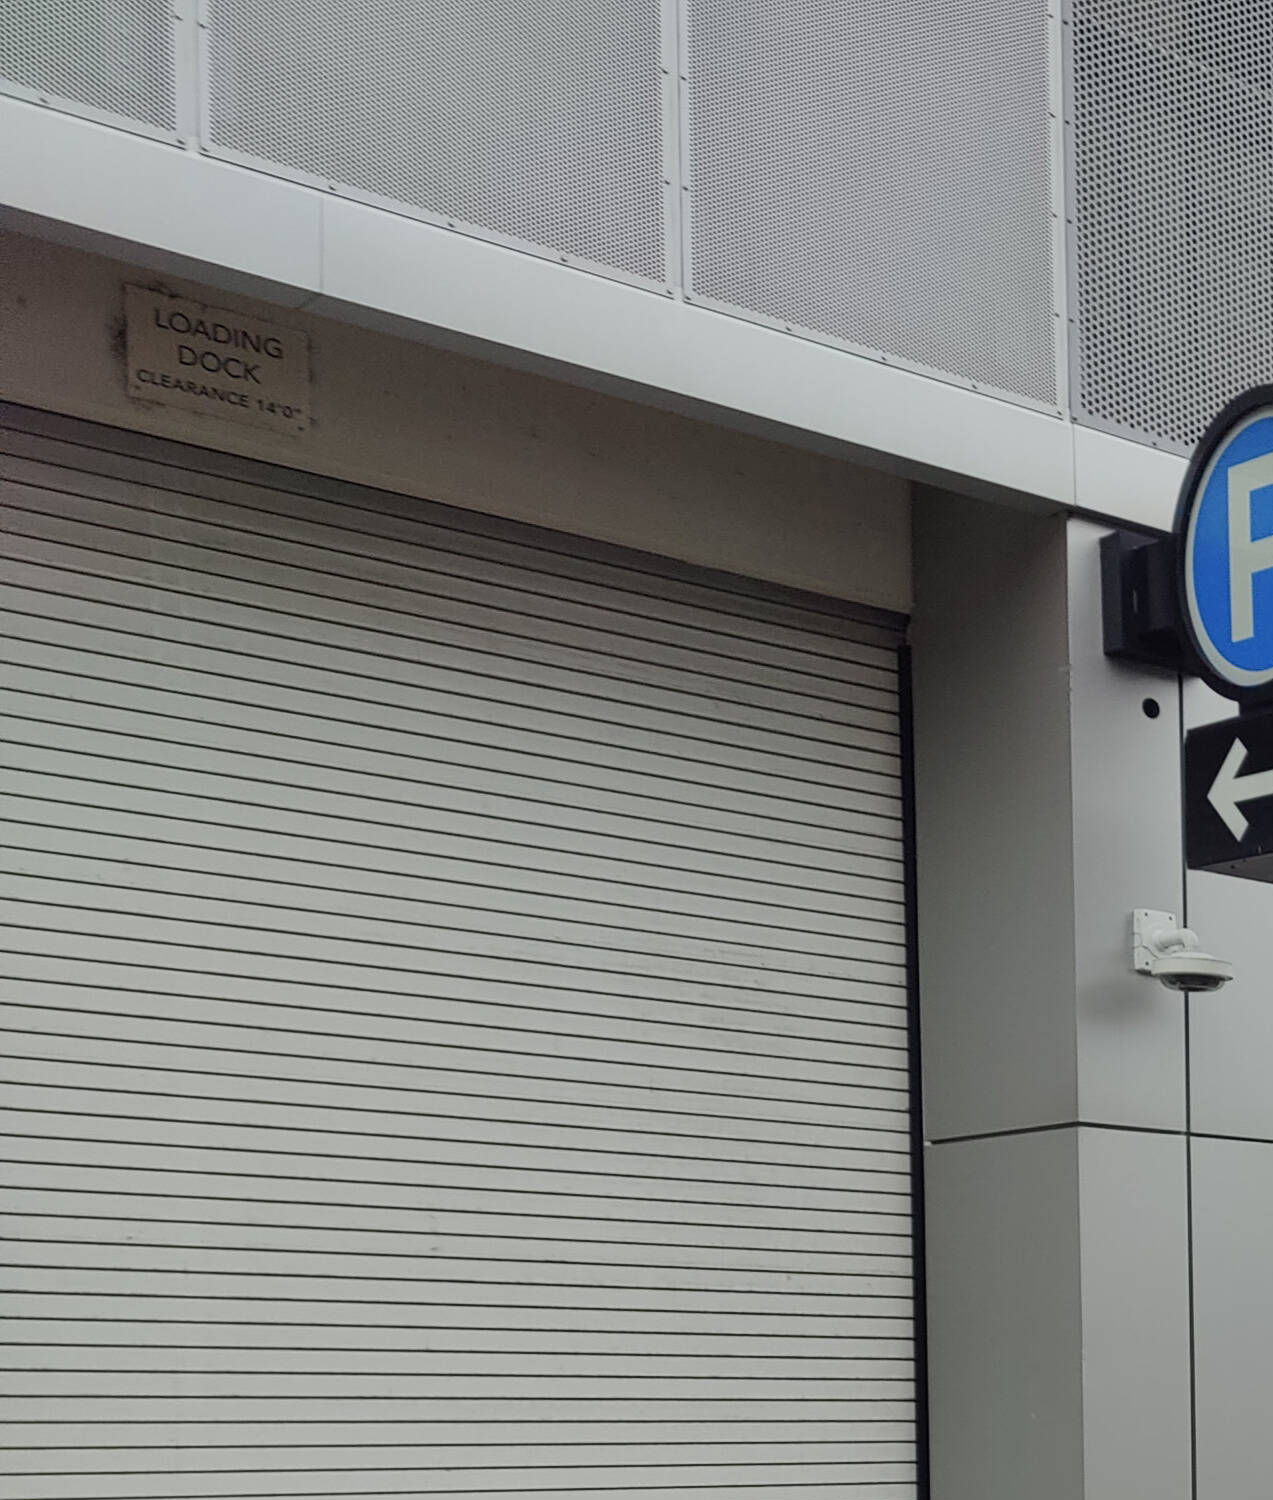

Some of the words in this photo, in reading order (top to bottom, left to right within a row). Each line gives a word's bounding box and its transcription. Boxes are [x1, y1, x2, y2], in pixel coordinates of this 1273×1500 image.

[154, 307, 284, 360] LOADING
[178, 345, 262, 385] DOCK
[137, 369, 250, 409] CLEARANCE
